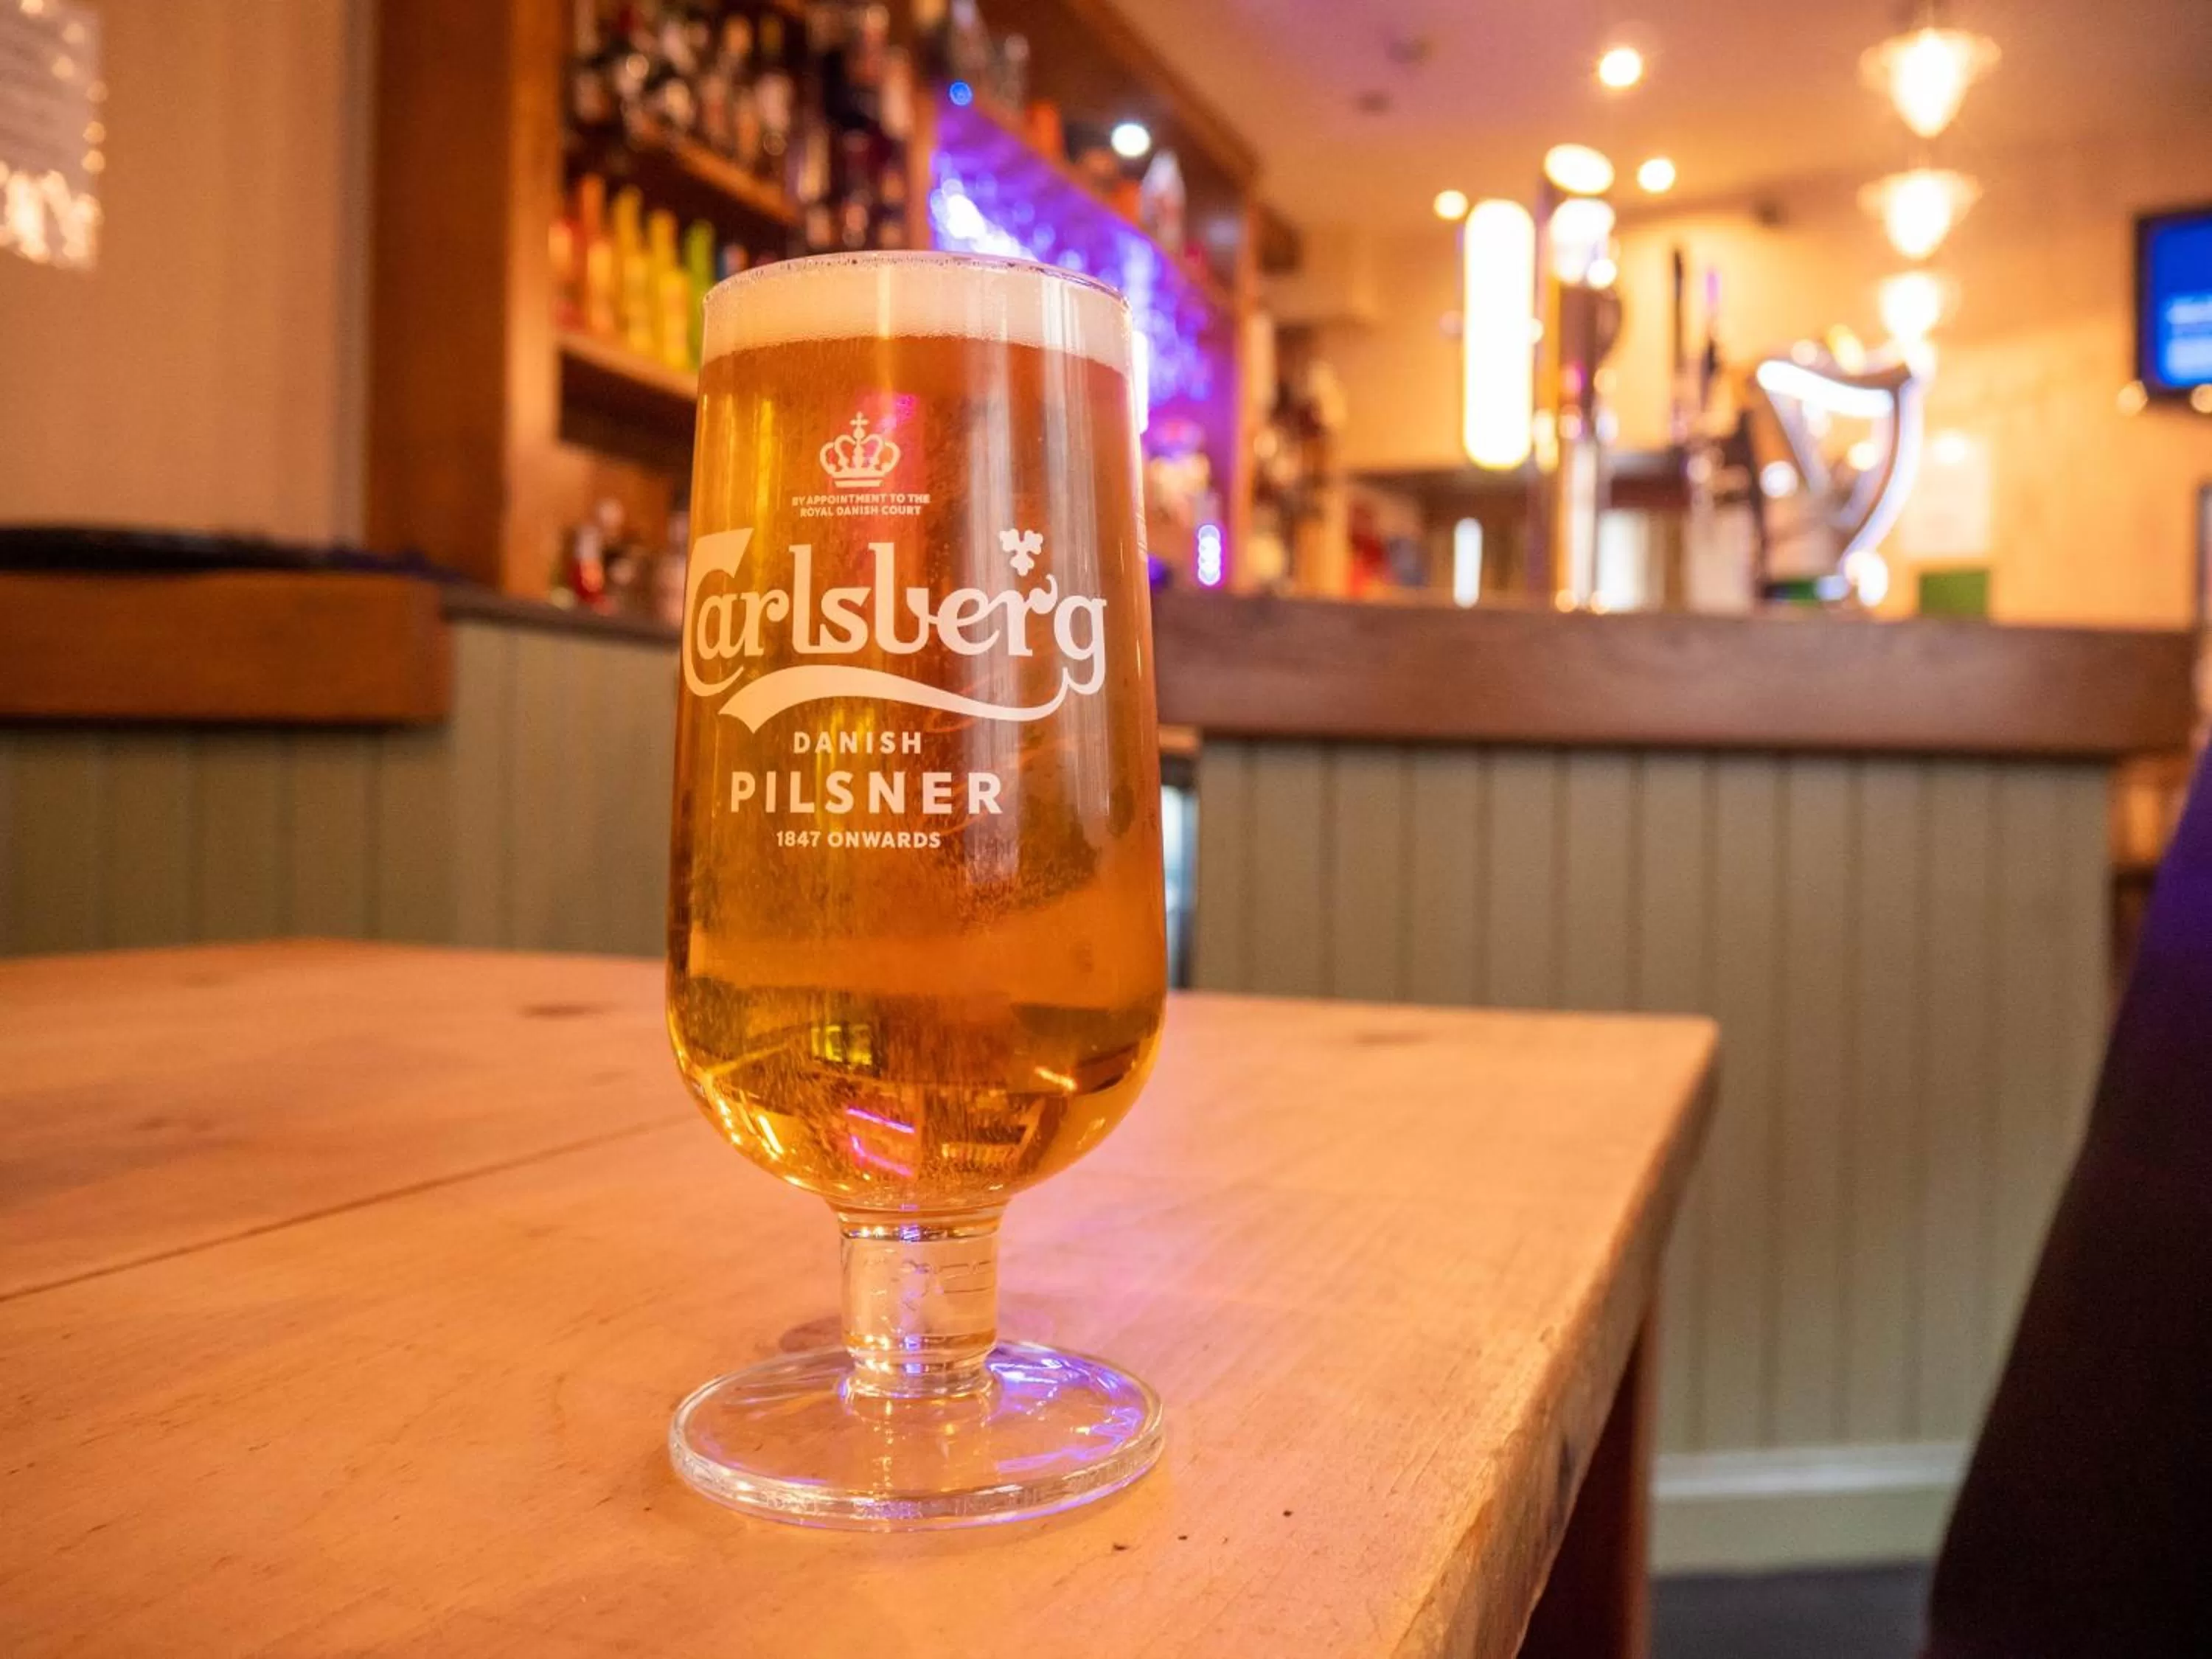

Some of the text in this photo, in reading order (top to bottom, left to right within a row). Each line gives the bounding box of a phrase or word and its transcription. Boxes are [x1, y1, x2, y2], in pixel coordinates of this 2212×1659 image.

[806, 494, 886, 505] APPOINTMENT
[890, 493, 905, 503] TO
[908, 493, 931, 504] THE
[800, 505, 921, 518] ROYAL DANISH COURT
[683, 527, 1107, 696] Carlsberg
[793, 731, 922, 754] DANISH
[731, 771, 1003, 815] PILSNER
[776, 831, 942, 849] 1847 ONWARDS
